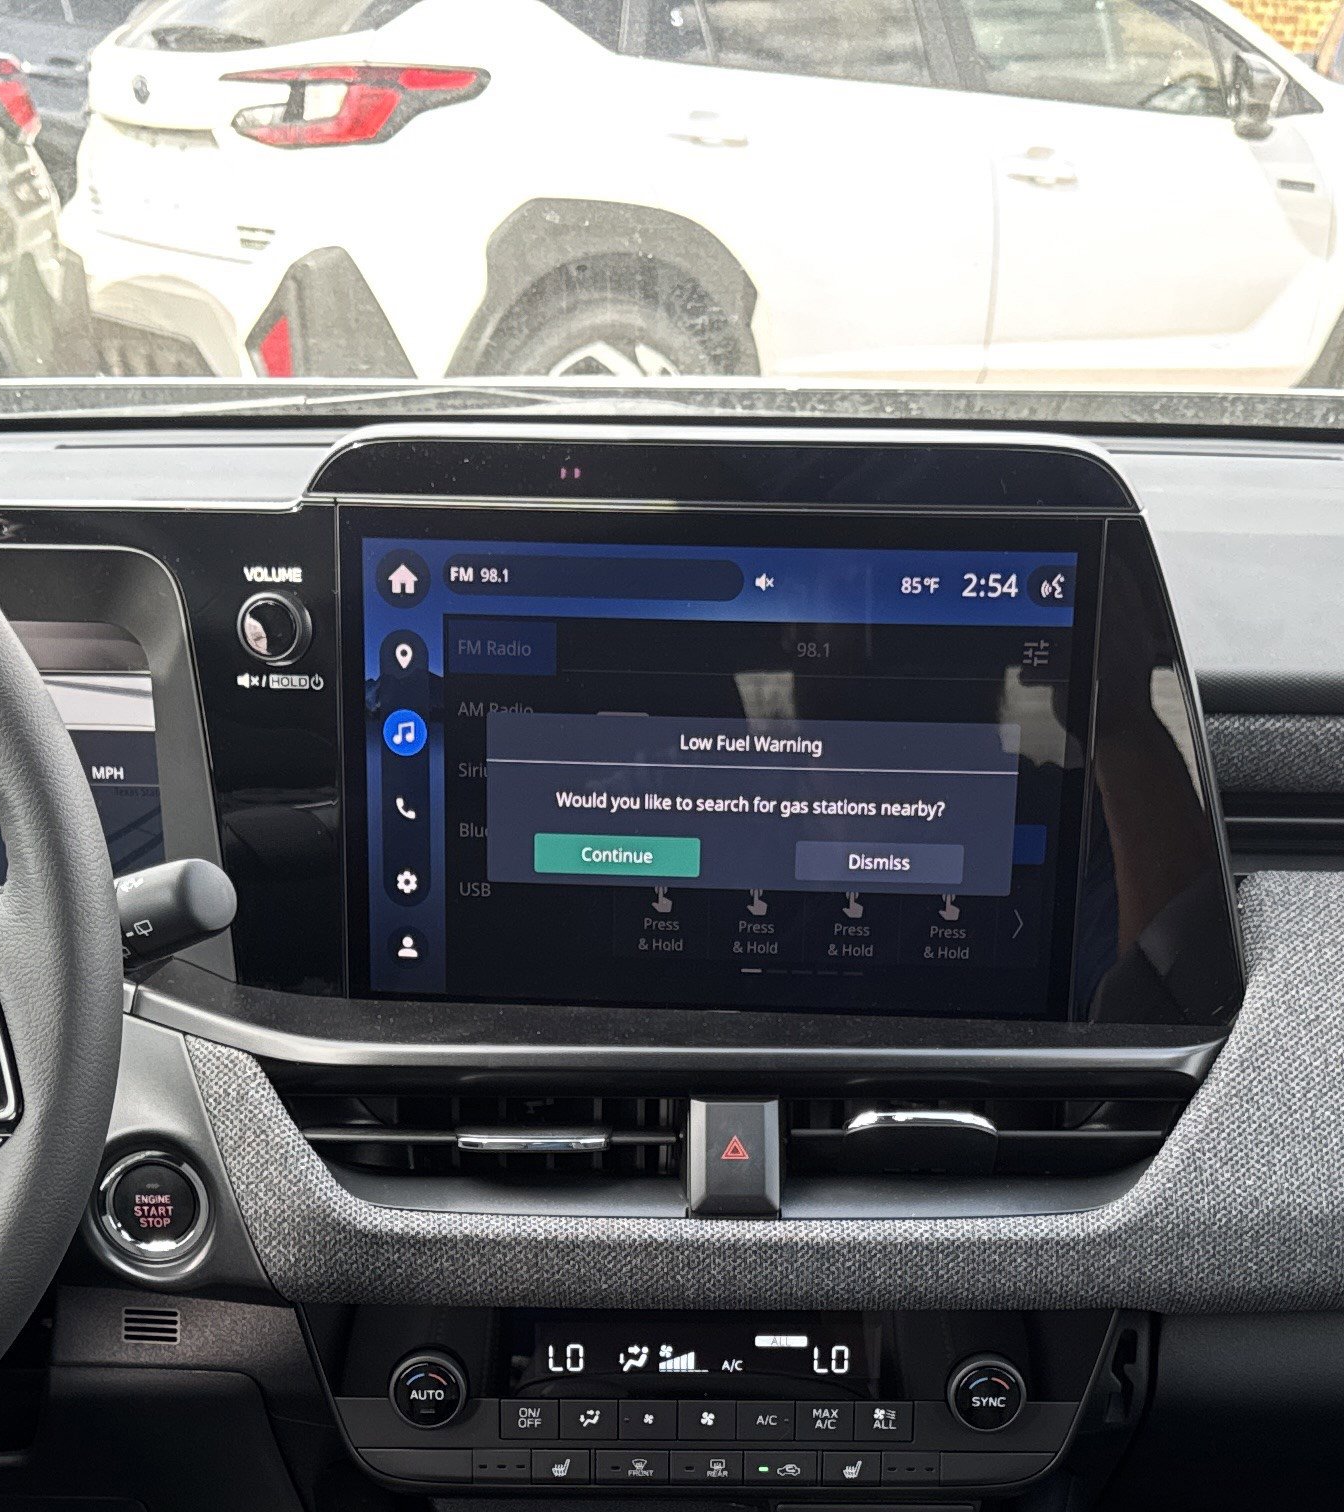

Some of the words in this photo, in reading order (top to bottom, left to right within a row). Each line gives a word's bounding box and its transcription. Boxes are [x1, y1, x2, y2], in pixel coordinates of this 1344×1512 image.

[243, 566, 303, 583] VOLUME
[450, 566, 474, 583] FM
[481, 567, 509, 583] 98.1
[961, 573, 1019, 598] 2:54
[458, 639, 481, 655] FM
[487, 640, 532, 657] Radio
[797, 642, 831, 658] 98.1
[270, 676, 307, 688] HOLD
[458, 701, 484, 717] AM
[679, 734, 712, 752] Low
[717, 734, 750, 753] Fuel
[754, 735, 823, 758] Warning
[91, 765, 125, 780] MPH
[556, 791, 607, 810] Would
[610, 796, 641, 813] you
[645, 793, 672, 811] like
[676, 796, 693, 811] to
[696, 795, 749, 813] search
[753, 797, 777, 813] for
[780, 801, 809, 818] gas
[812, 798, 877, 816] stations
[880, 801, 946, 821] nearby?
[581, 846, 654, 865] Continue
[848, 853, 911, 872] Dismiss
[459, 882, 492, 897] USB
[643, 917, 680, 931] Press
[738, 920, 775, 934] Press
[834, 923, 870, 937] Press
[930, 925, 966, 939] Press
[638, 938, 649, 951] &
[652, 938, 684, 952] Hold
[733, 941, 743, 954] &
[746, 941, 778, 955] Hold
[828, 944, 838, 956] &
[842, 944, 874, 958] Hold
[924, 946, 934, 959] &
[938, 946, 970, 960] Hold
[134, 1194, 171, 1205] ENGINE
[133, 1205, 174, 1217] START
[139, 1217, 171, 1228] STOP
[721, 1359, 743, 1372] A/C
[409, 1389, 445, 1401] AUTO
[971, 1396, 1007, 1408] SYNC
[518, 1407, 541, 1418] ON/
[812, 1408, 839, 1419] MAX
[517, 1418, 542, 1428] OFF
[756, 1414, 778, 1426] A/C
[814, 1419, 837, 1430] A/C
[873, 1419, 897, 1430] ALL
[706, 1470, 729, 1478] REAR
